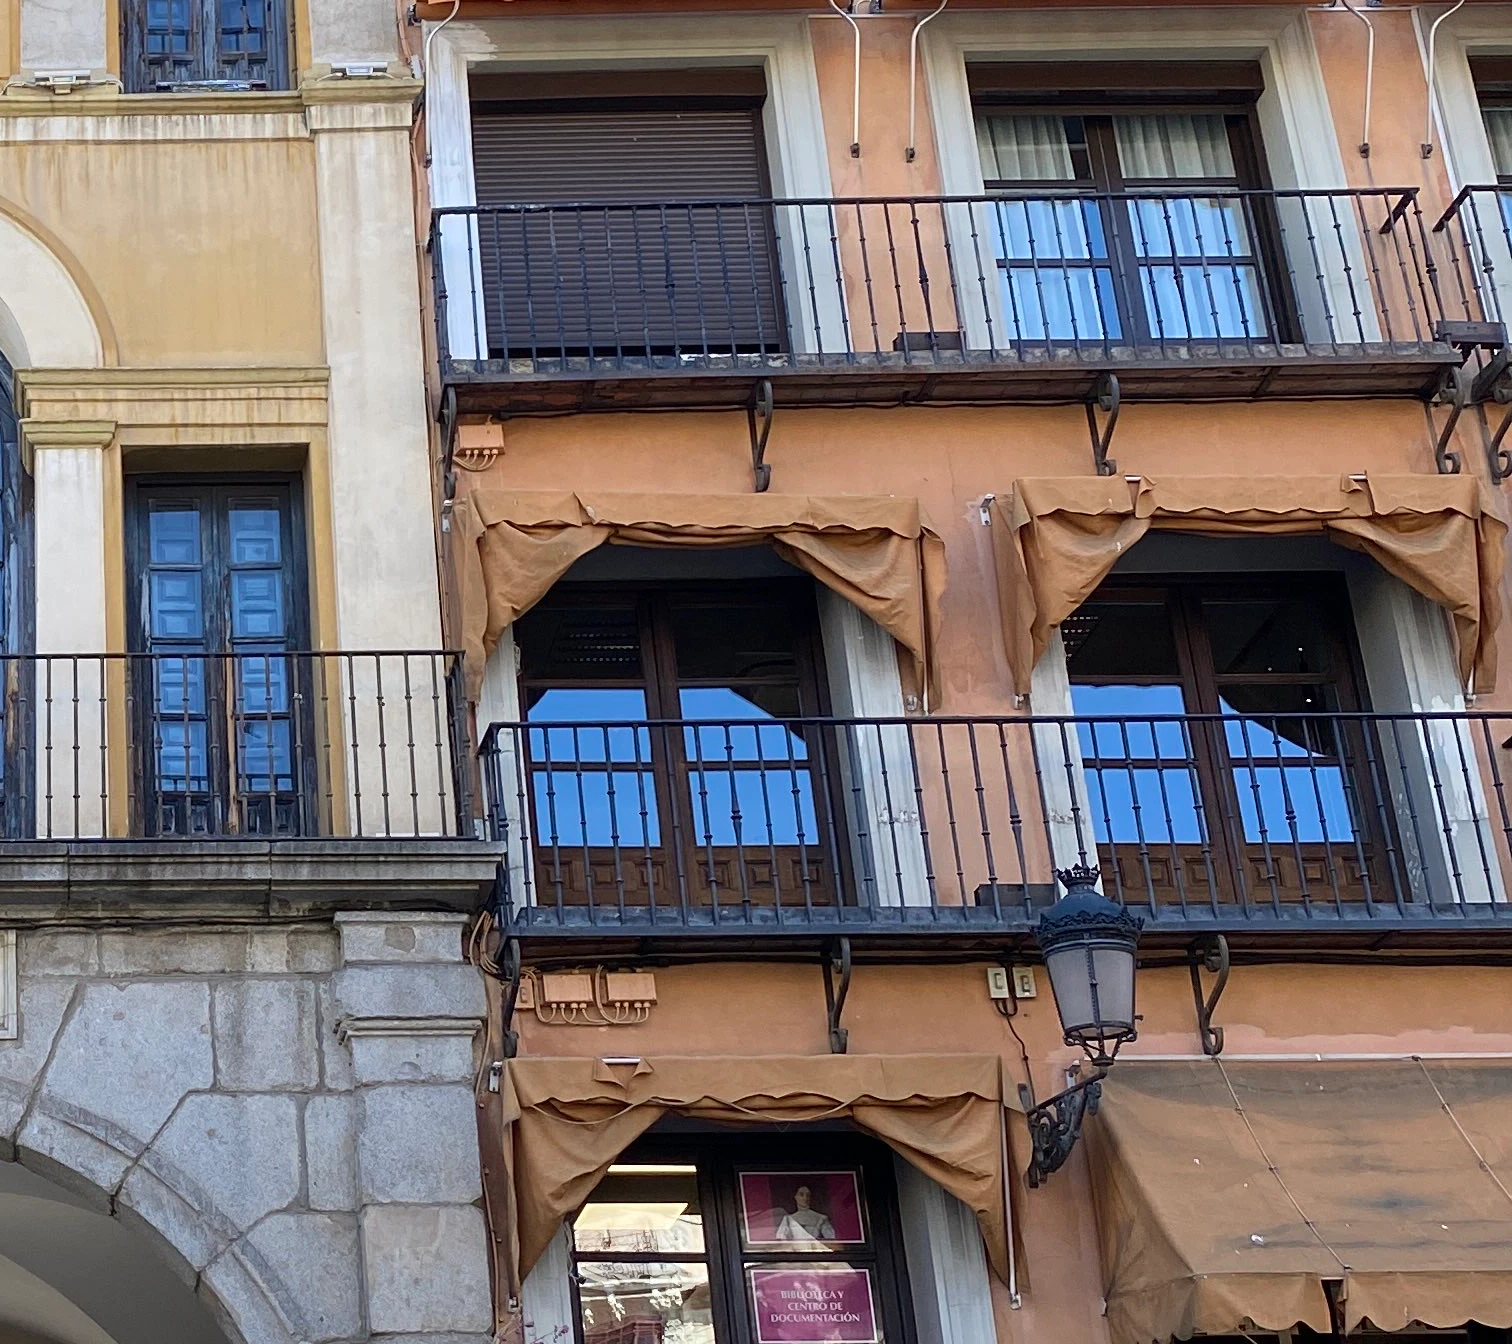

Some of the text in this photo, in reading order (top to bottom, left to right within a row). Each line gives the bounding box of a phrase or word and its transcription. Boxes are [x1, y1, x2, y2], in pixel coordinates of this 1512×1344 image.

[788, 1302, 843, 1311] CENTRO DE
[770, 1312, 860, 1323] DOCUMENTACIÓN
